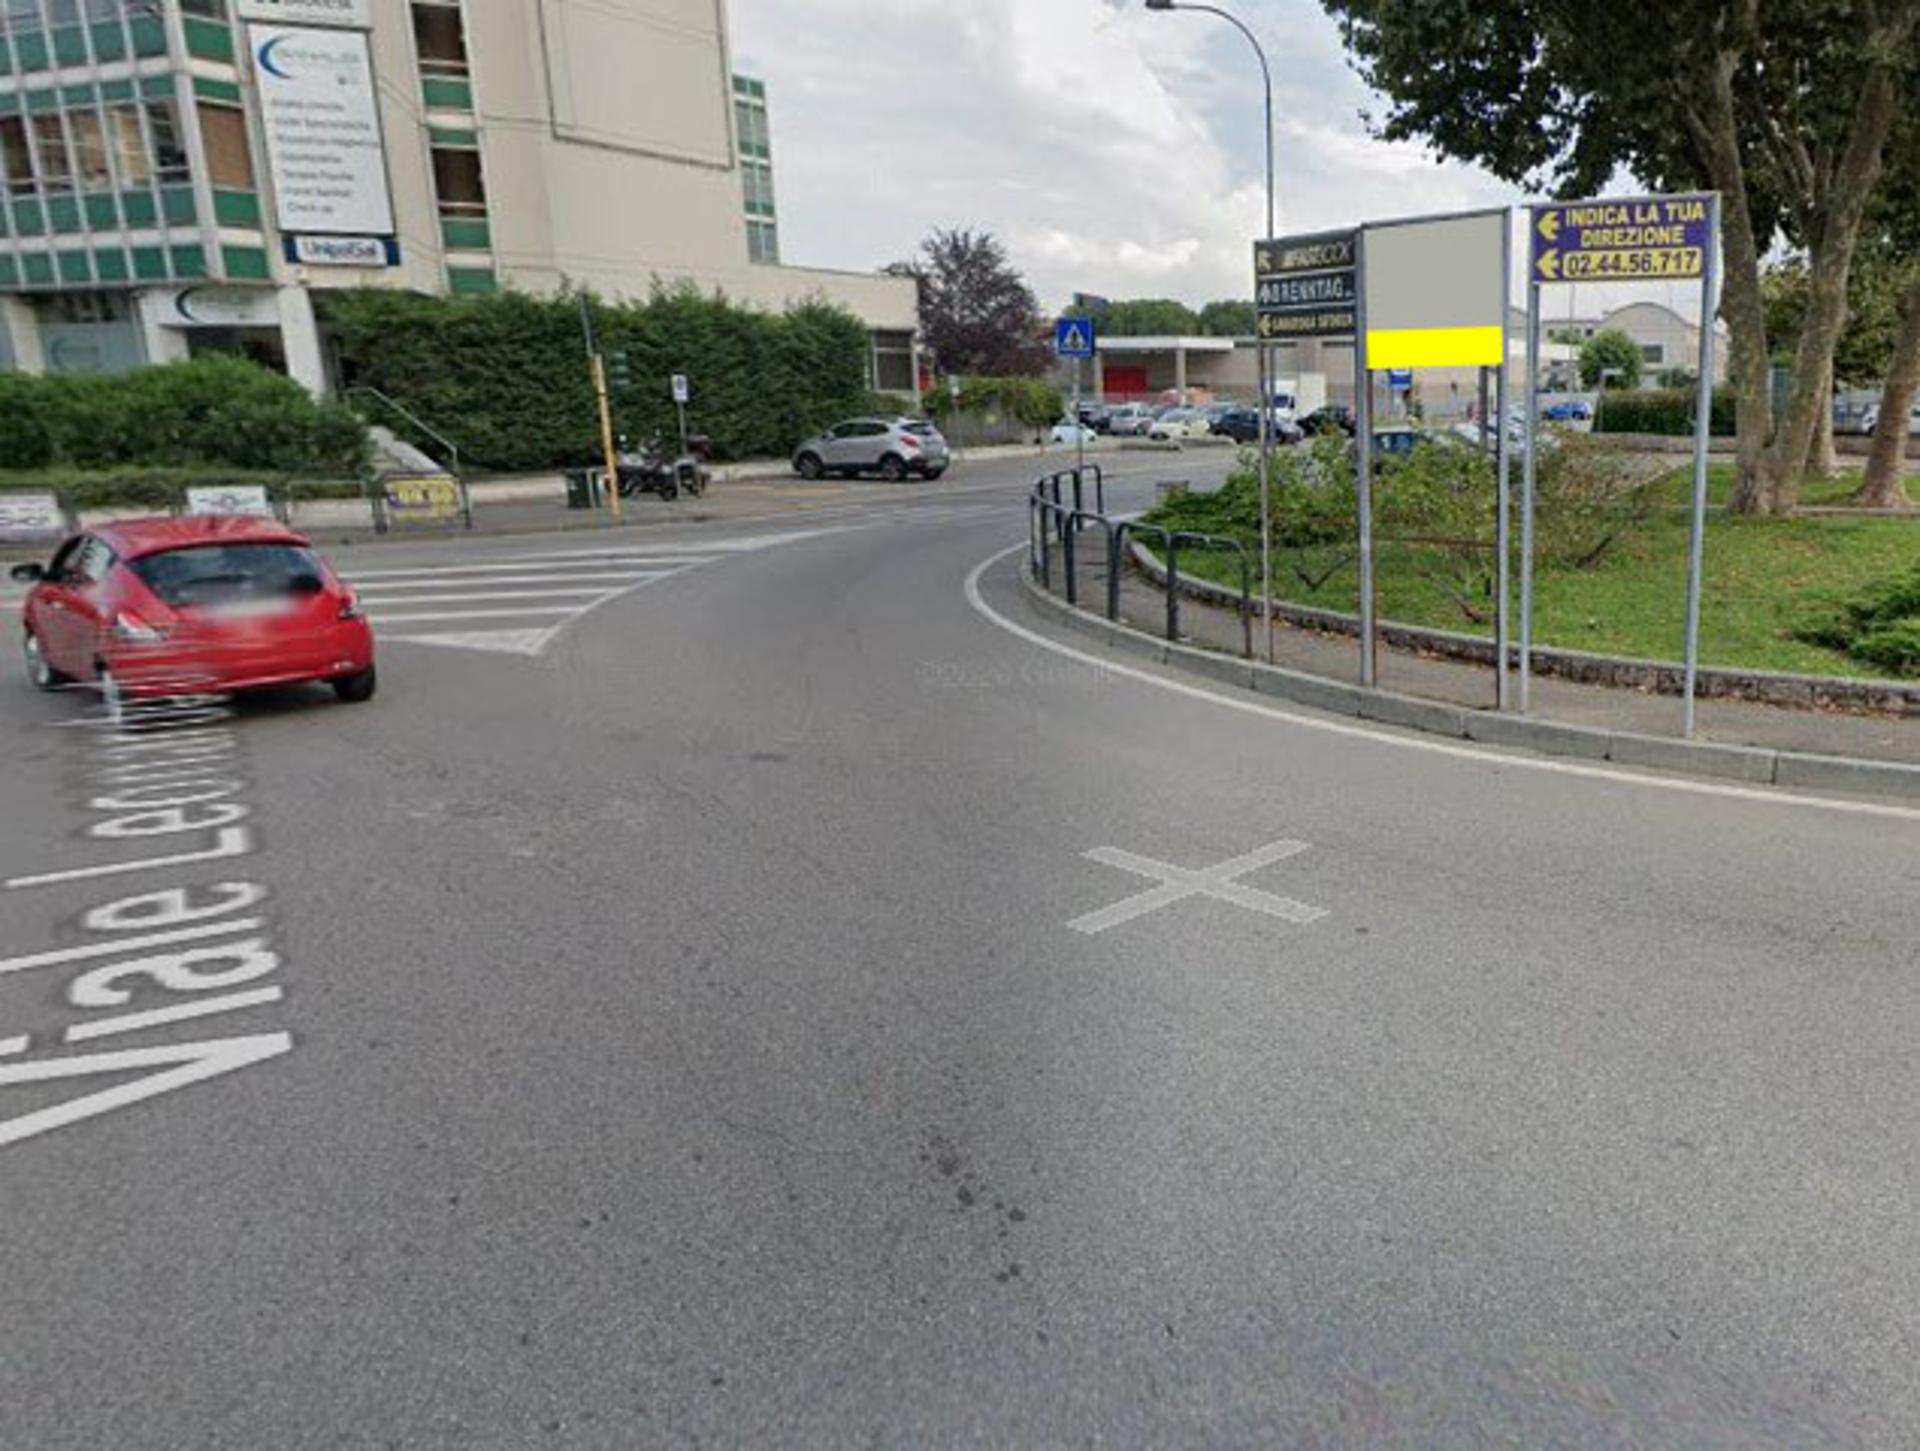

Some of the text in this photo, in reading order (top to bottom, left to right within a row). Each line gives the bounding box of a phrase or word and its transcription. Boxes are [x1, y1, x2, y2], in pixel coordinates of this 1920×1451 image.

[1565, 201, 1705, 227] INDICA LA TUA
[1580, 225, 1686, 248] DIREZIONE
[1568, 250, 1698, 275] 02.44.56.717
